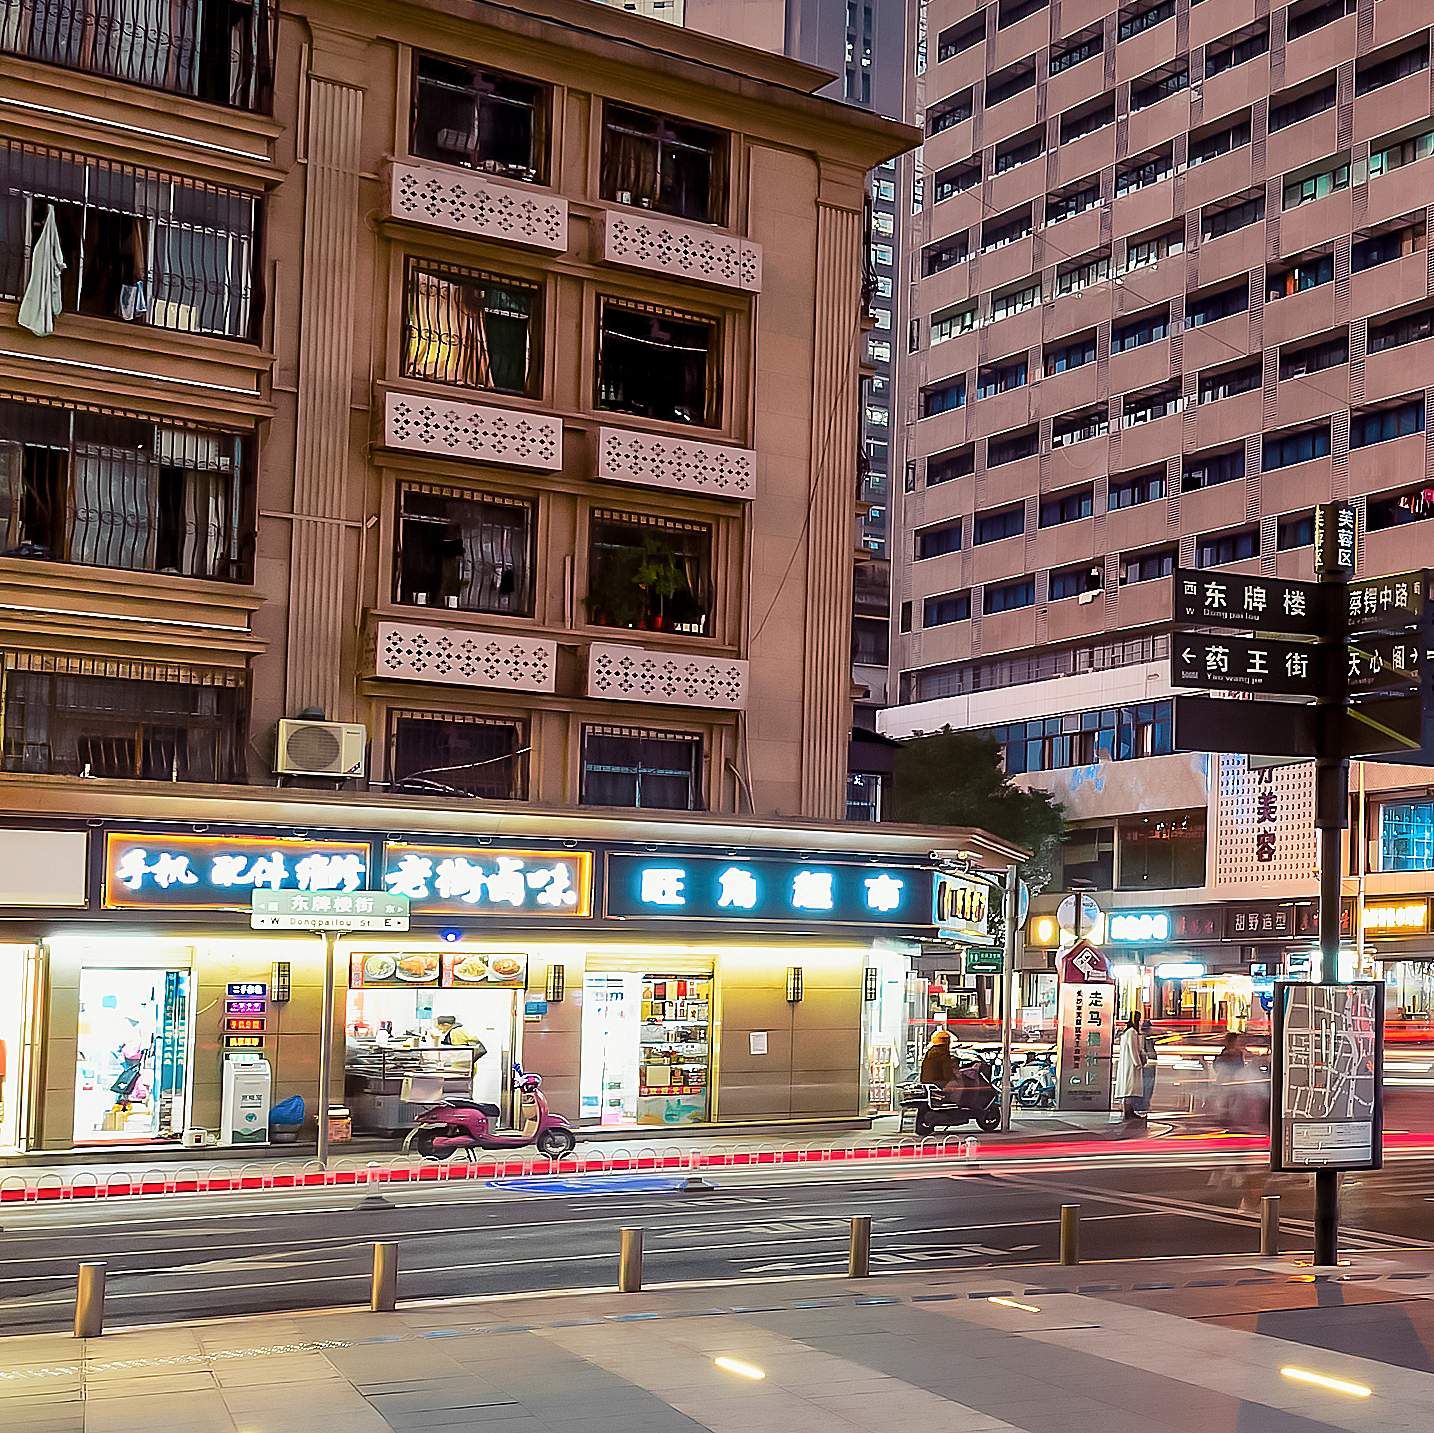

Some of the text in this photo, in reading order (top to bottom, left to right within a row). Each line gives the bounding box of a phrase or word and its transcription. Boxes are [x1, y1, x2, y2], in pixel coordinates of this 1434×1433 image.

[1337, 508, 1354, 567] 芙蓉区
[1183, 580, 1306, 617] 西 东牌楼
[1186, 607, 1195, 615] W
[1349, 581, 1408, 616] 蔡锷中路
[1205, 645, 1308, 678] 药王街
[1348, 644, 1405, 677] 天心阁
[291, 895, 374, 914] 东牌楼街
[640, 866, 904, 912] 旺角超市
[384, 918, 392, 927] E
